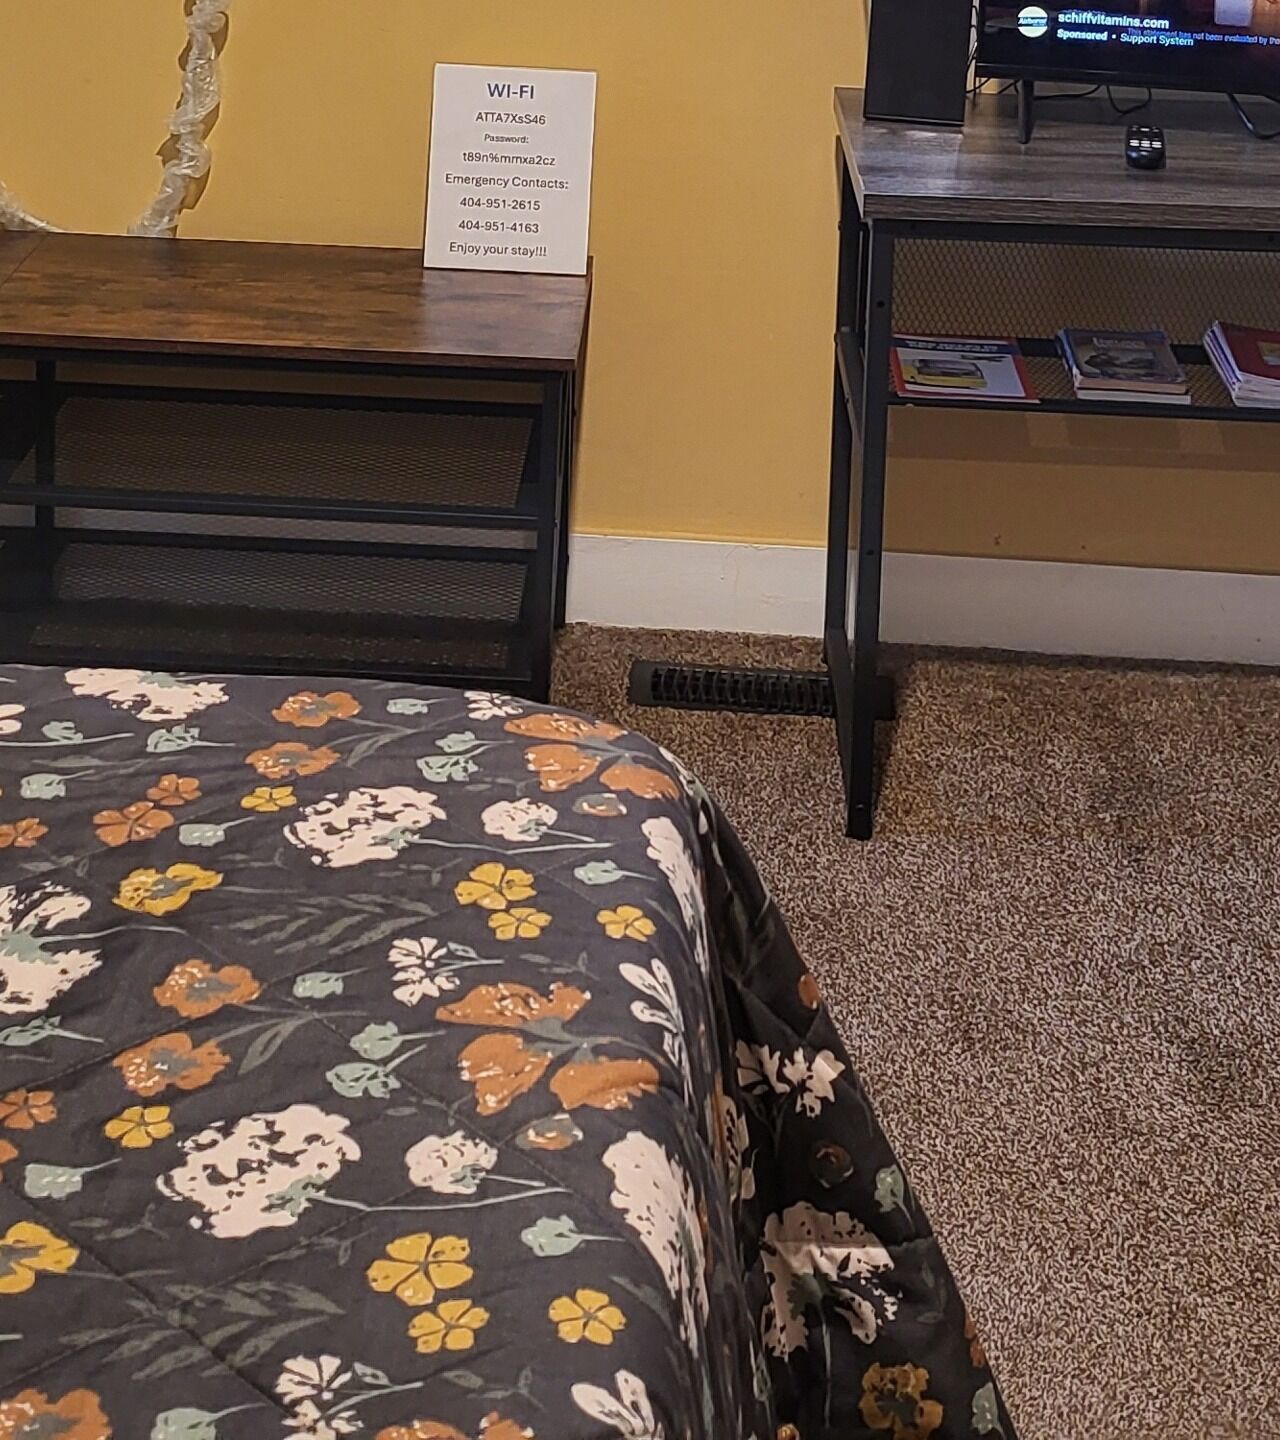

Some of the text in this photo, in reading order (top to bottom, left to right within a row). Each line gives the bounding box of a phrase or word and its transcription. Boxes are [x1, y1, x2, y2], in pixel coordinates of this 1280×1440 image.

[1058, 12, 1170, 30] schiffvitamins.com
[1056, 28, 1195, 47] Sponsored Support System
[1258, 36, 1268, 46] by
[487, 82, 535, 100] WI-FI
[475, 111, 546, 125] ATTA7XsS46
[484, 133, 529, 144] Password:
[445, 173, 569, 190] Emergency Contacts:
[459, 197, 541, 211] 404-951-2615
[458, 220, 539, 233] 404-951-4163
[449, 242, 547, 258] Enjoy your stay!!!
